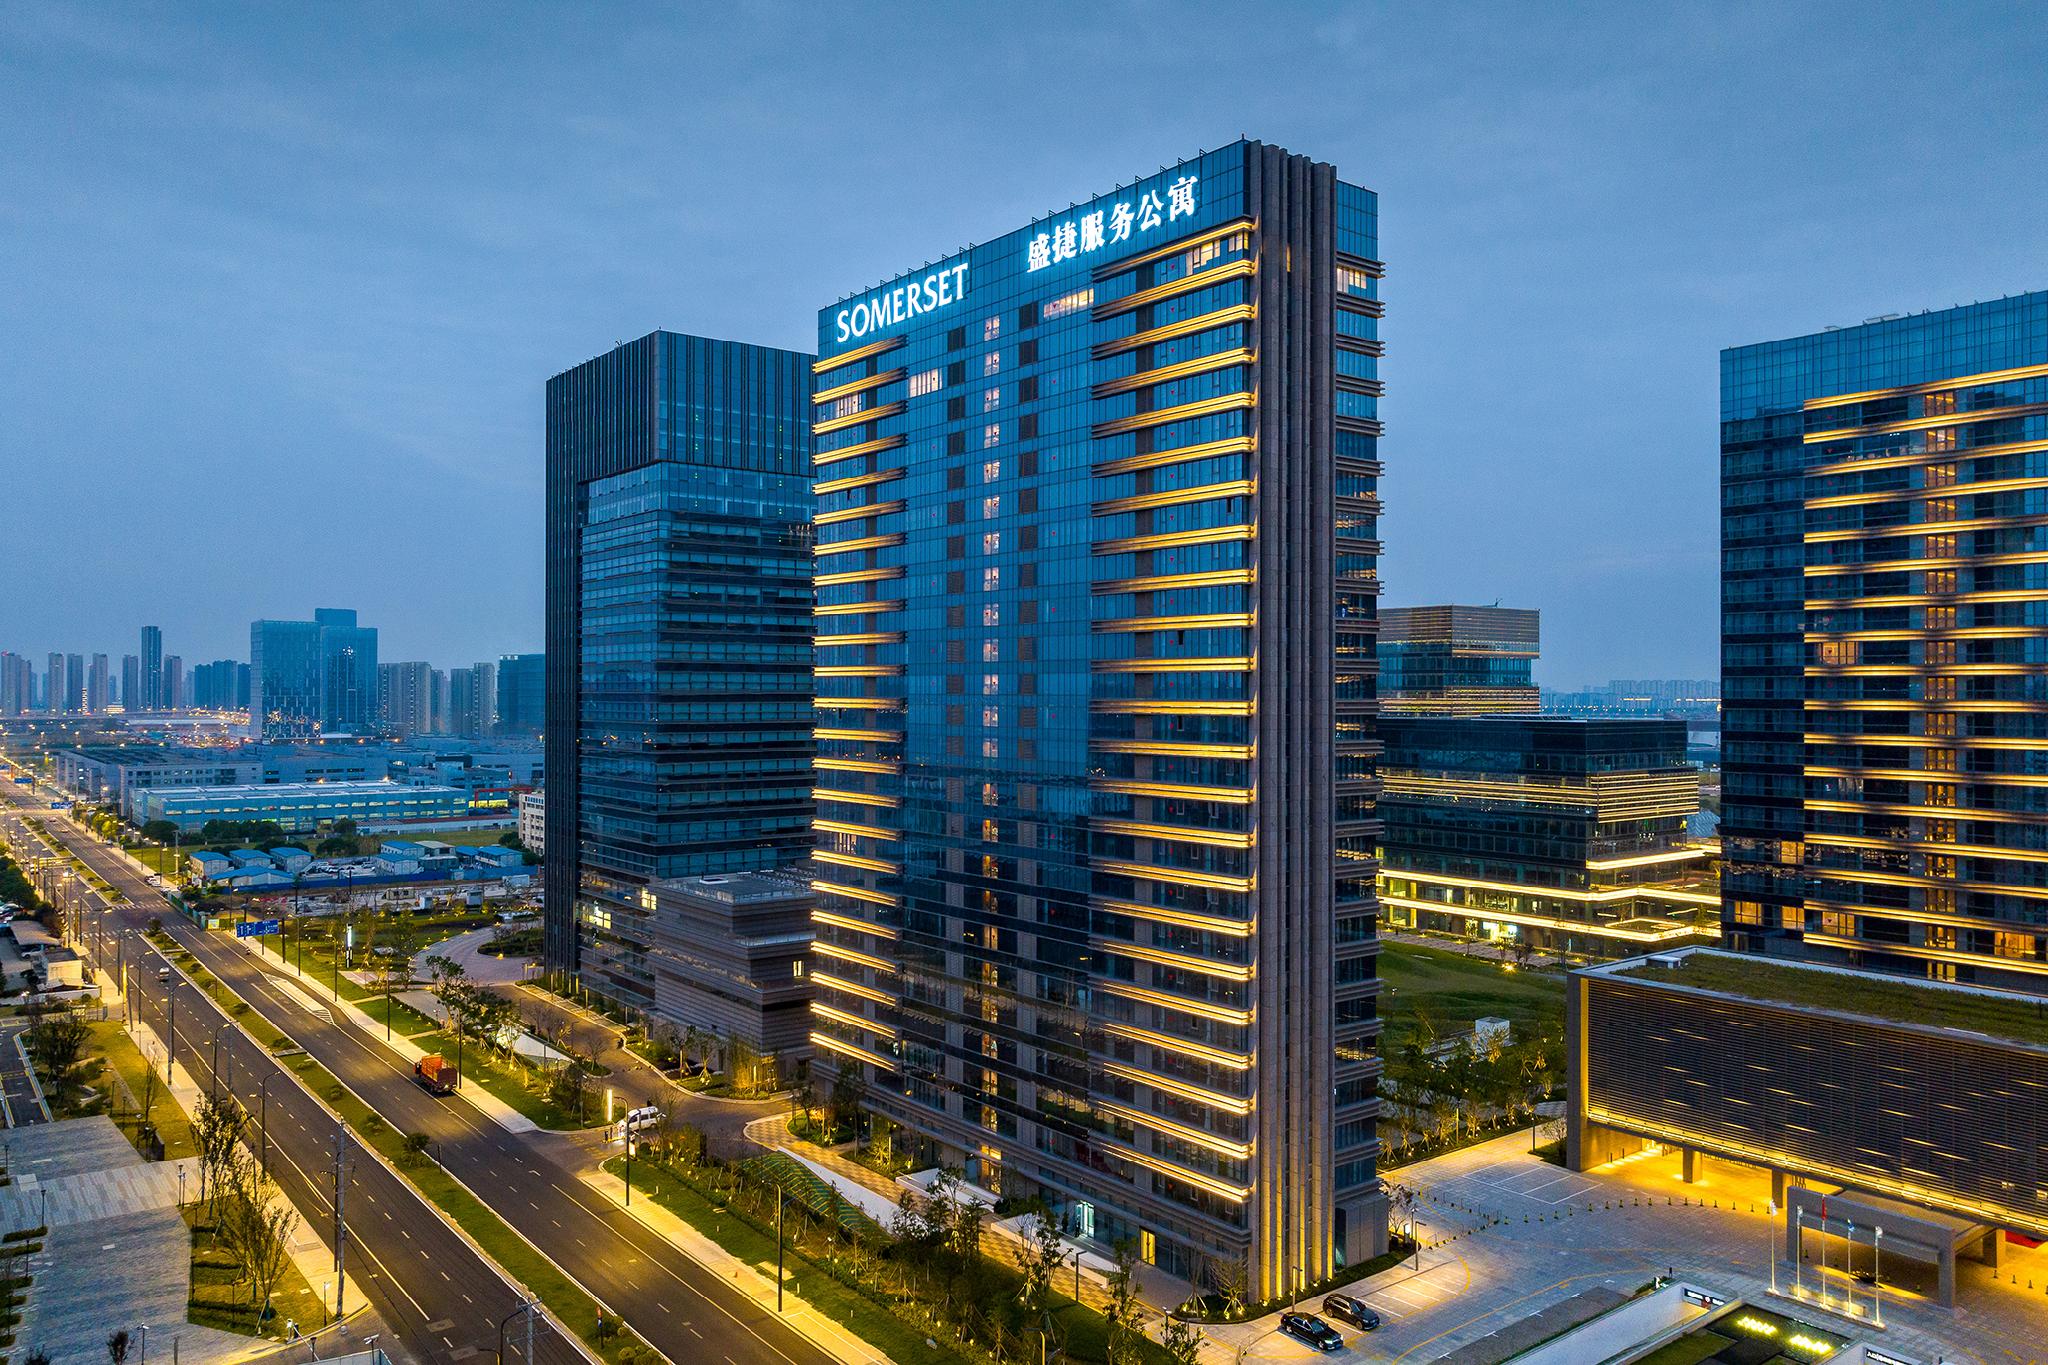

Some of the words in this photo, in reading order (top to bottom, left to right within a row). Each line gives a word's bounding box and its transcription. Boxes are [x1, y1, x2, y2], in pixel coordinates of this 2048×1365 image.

[1027, 175, 1198, 273] 盛捷服务公寓
[836, 262, 969, 343] SOMERSET
